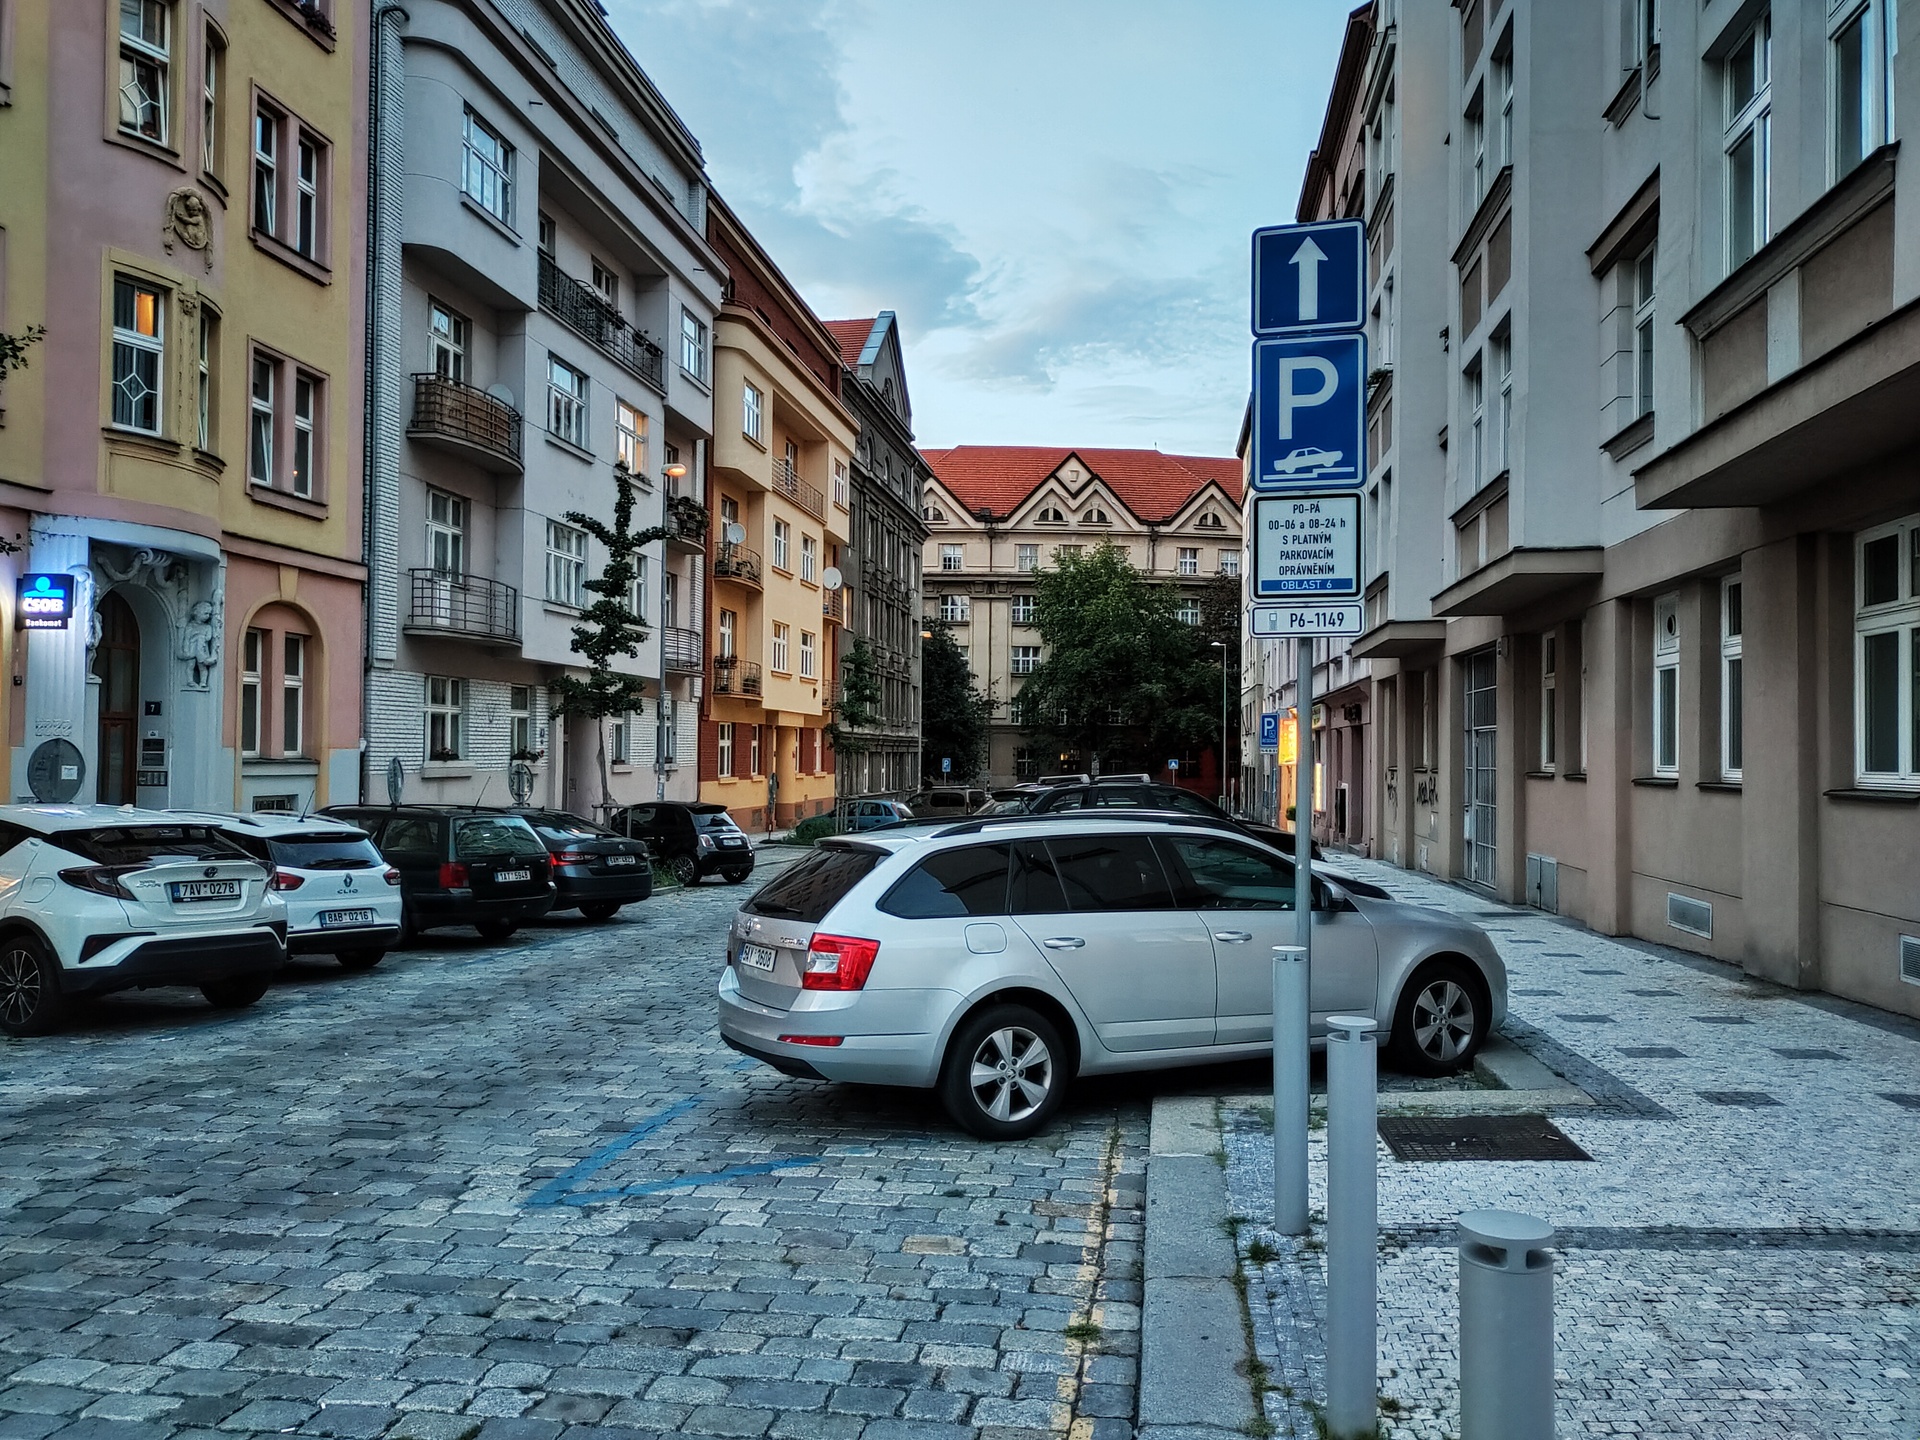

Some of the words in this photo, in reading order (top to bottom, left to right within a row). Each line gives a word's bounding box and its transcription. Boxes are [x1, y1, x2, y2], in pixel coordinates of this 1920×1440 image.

[1278, 356, 1339, 440] P
[1292, 501, 1321, 514] PO-PÁ
[1268, 519, 1296, 531] 00-06
[1299, 521, 1305, 530] a
[1308, 518, 1336, 529] 08-24
[1340, 517, 1346, 528] h
[1282, 534, 1289, 545] S
[1292, 531, 1332, 545] PLATNÝM
[1280, 546, 1334, 561] PARKOVACÍM
[1278, 562, 1335, 576] OPRÁVNĚNÍM
[1281, 580, 1321, 590] OBLAST
[1326, 580, 1333, 589] 6
[25, 618, 62, 627] Bankomat
[1289, 612, 1345, 628] P6-1149
[1264, 717, 1275, 737] P
[181, 884, 202, 897] 7AV
[209, 882, 235, 895] 0278
[327, 912, 344, 923] 8AB
[348, 911, 369, 921] 0216
